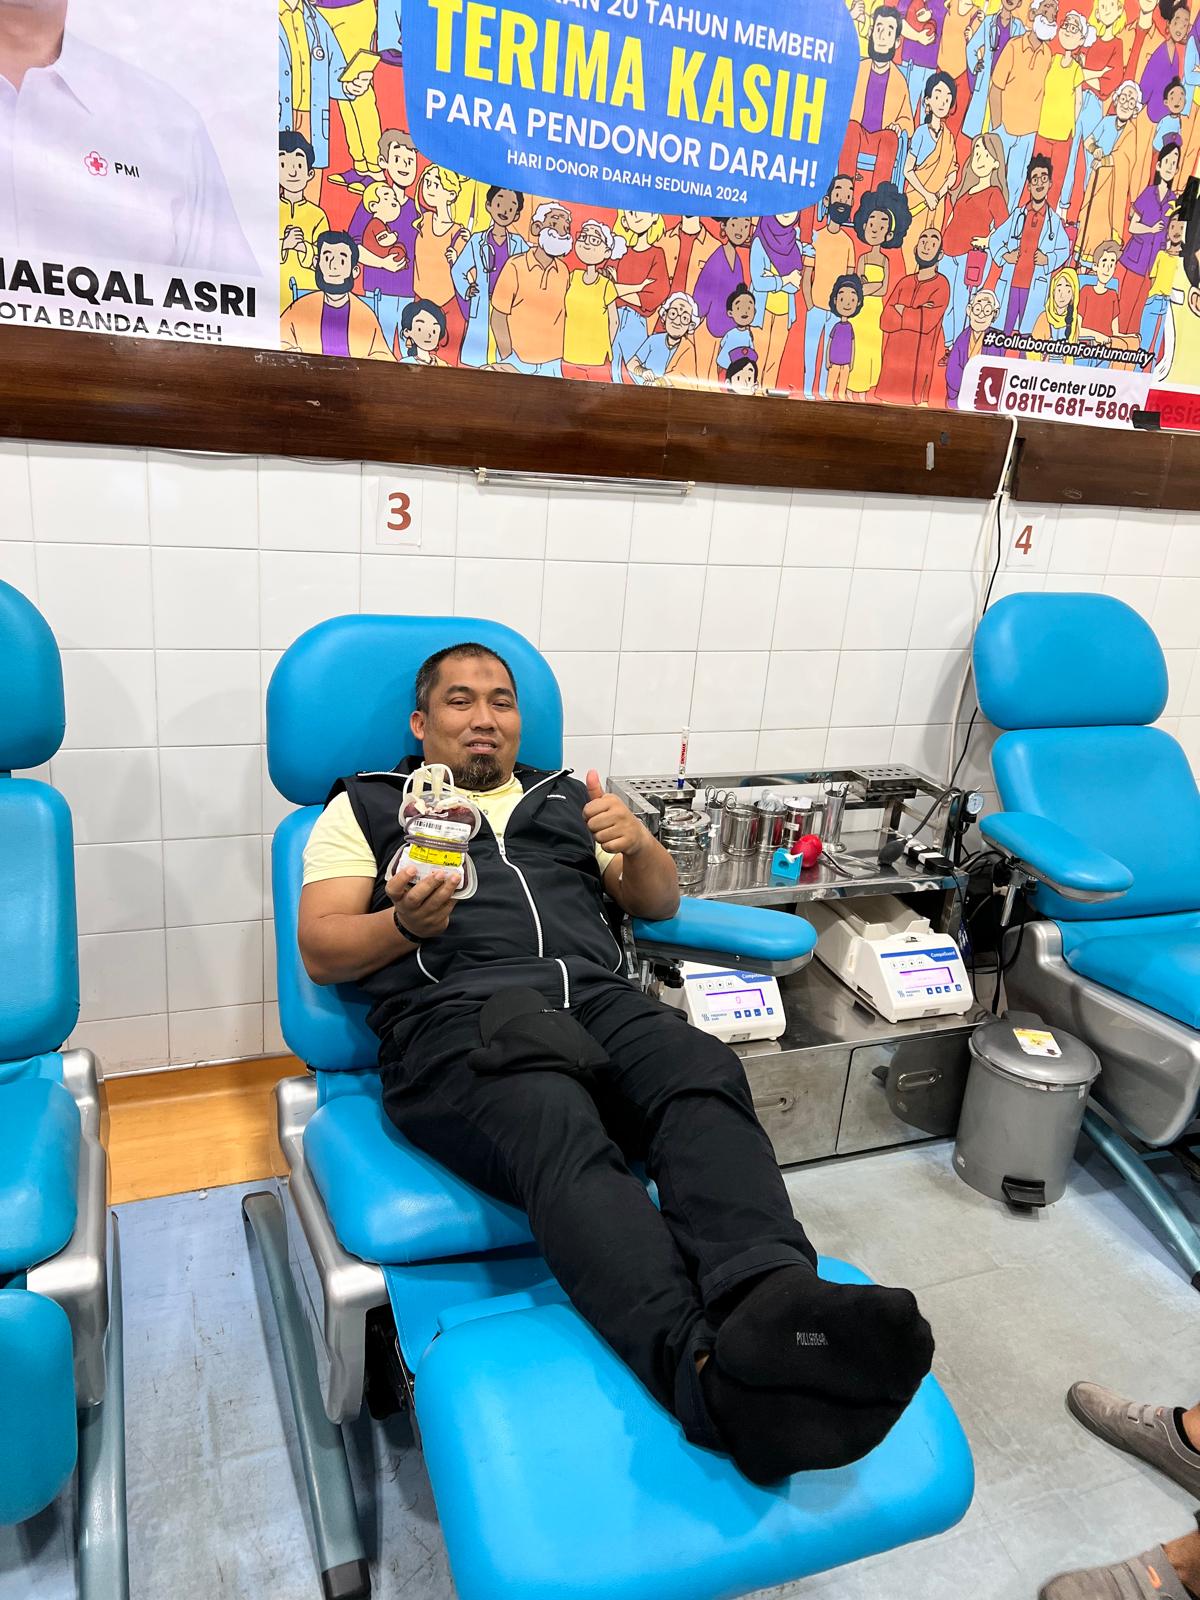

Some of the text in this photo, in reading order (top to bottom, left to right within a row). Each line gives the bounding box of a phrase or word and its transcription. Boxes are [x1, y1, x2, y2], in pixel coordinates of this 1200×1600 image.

[607, 0, 835, 64] 20 TAHUN MEMBERI
[428, 0, 828, 145] TERIMA KASIH
[425, 88, 818, 188] PARA PENDONOR DARAH!
[114, 161, 140, 178] PMI
[507, 149, 749, 204] HARI DONOR DARAH SEDUNIA 2024
[162, 277, 256, 318] ASRI
[58, 307, 150, 334] BANDA
[156, 318, 223, 341] ACEH
[984, 333, 1153, 367] #CollaborationForHumanity
[1009, 374, 1117, 399] Call Center UDD
[387, 491, 412, 531] 3
[1014, 525, 1033, 555] 4
